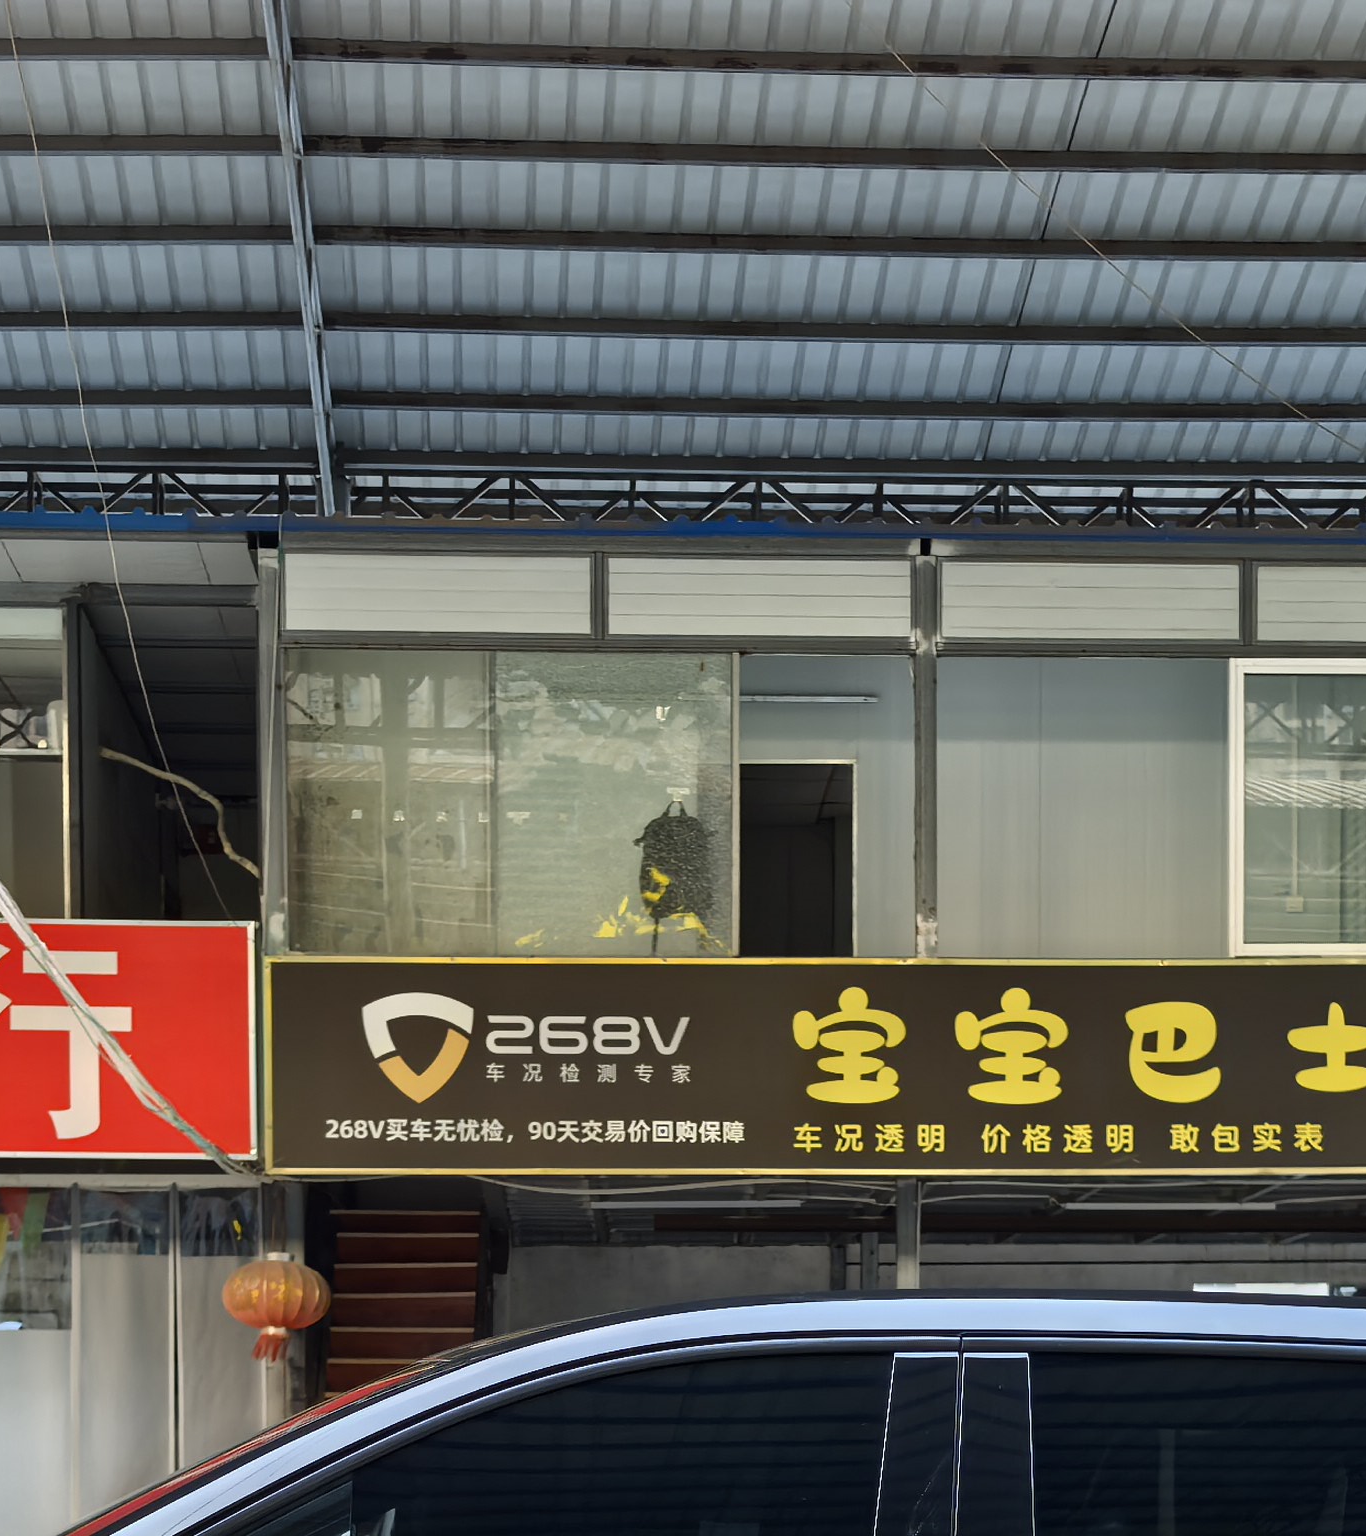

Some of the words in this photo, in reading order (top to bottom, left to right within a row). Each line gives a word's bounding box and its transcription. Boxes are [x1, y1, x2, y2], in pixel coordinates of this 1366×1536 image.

[485, 1014, 691, 1056] 268V
[485, 1062, 692, 1084] 车况检测专家
[793, 1121, 946, 1153] 车况透明
[981, 1122, 1135, 1153] 价格透明
[1169, 1122, 1326, 1153] 敢包实表
